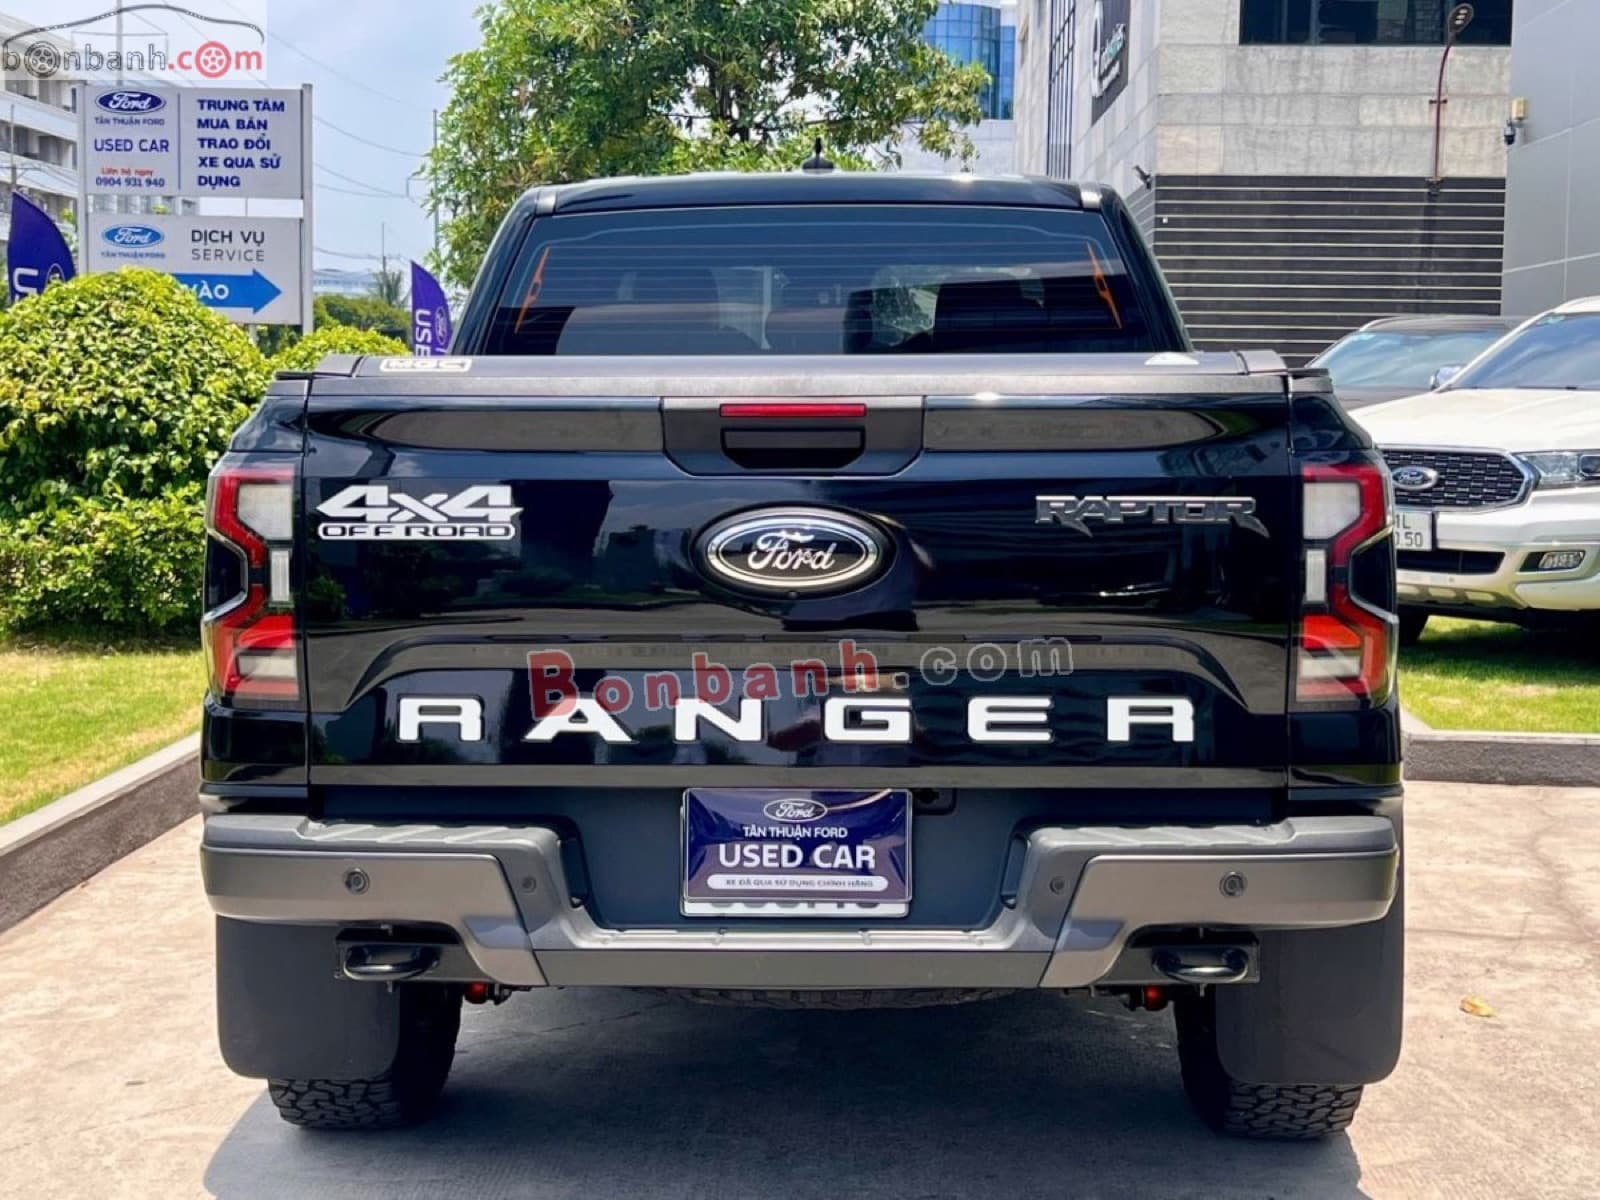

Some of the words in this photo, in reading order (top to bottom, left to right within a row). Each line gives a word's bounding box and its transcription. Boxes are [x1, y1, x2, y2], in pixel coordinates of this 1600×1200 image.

[108, 92, 152, 109] Ford
[197, 99, 249, 111] TRUNG
[253, 98, 285, 112] TÂM
[197, 118, 230, 129] MUA
[236, 116, 268, 130] BÁN
[94, 138, 133, 152] USED
[138, 138, 169, 153] CAR
[197, 137, 239, 149] TRAO
[244, 132, 271, 151] ĐỔI
[198, 156, 219, 168] XE
[223, 157, 255, 169] QUA
[197, 175, 241, 190] DỤNG
[114, 228, 152, 244] Ford
[191, 229, 233, 247] DỊCH
[240, 230, 265, 247] VỤ
[191, 248, 265, 262] SERVICE
[415, 308, 431, 357] USE
[316, 484, 524, 522] 4x4
[1035, 495, 1270, 538] RAPTOR
[322, 524, 395, 537] OFF
[405, 524, 510, 537] ROAD
[747, 529, 838, 571] Ford
[399, 697, 1195, 743] RANGER
[775, 802, 815, 818] Ford
[742, 824, 767, 838] TÂN
[768, 824, 812, 841] THUẬN
[814, 826, 848, 838] FORD
[719, 844, 804, 868] USED
[812, 845, 876, 869] CAR
[753, 879, 773, 888] QUA
